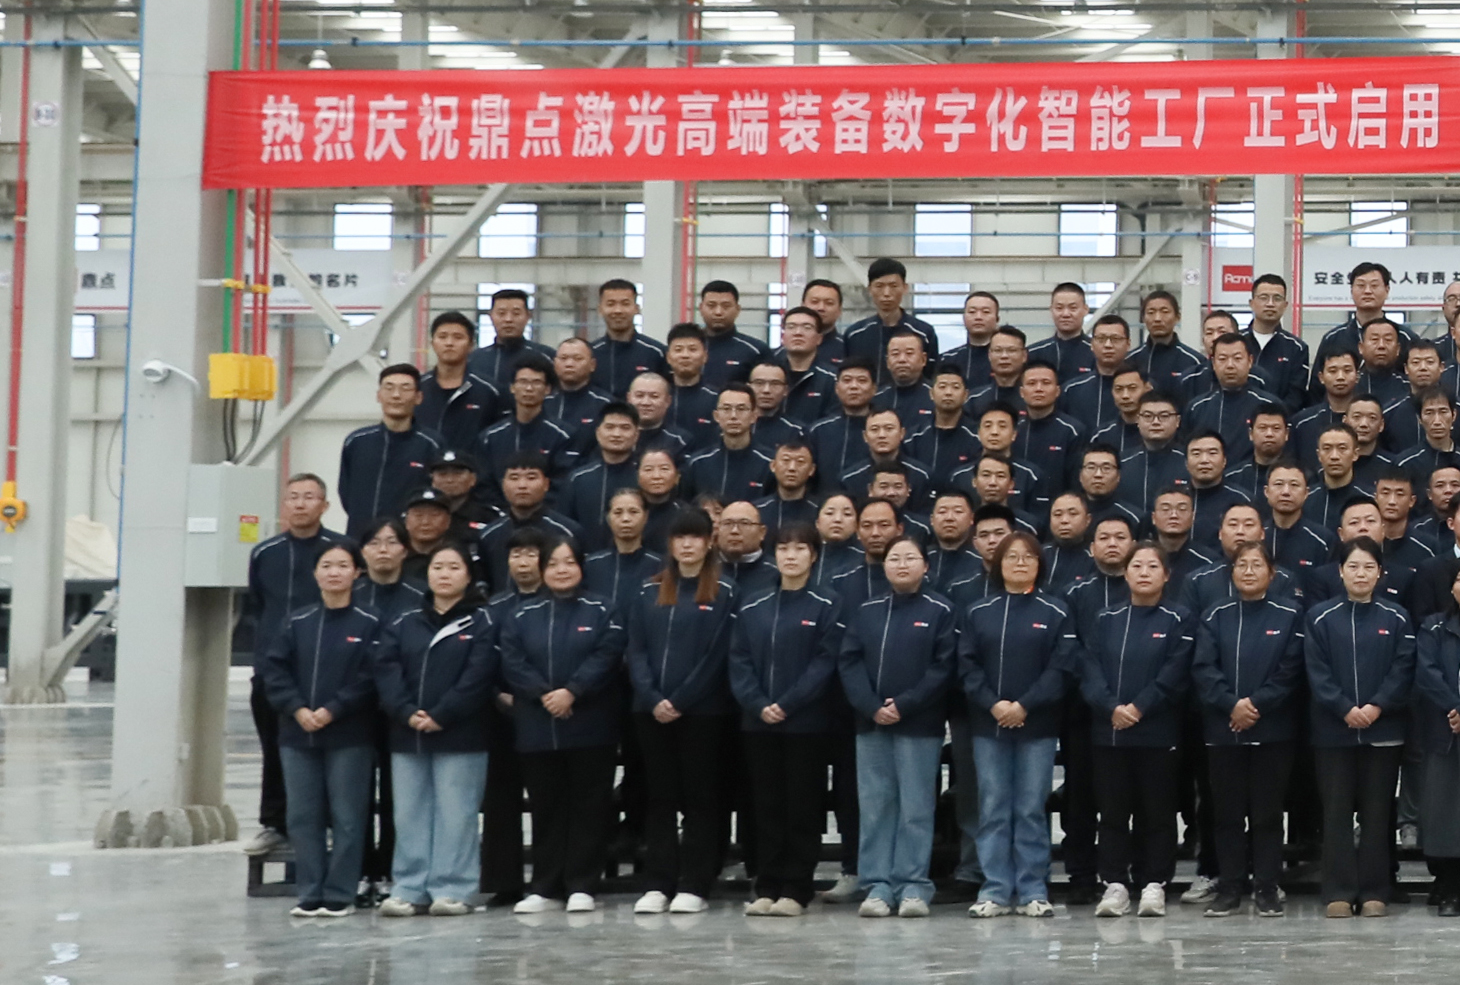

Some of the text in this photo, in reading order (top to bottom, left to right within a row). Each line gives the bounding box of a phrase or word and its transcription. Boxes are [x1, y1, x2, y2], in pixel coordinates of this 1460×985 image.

[260, 81, 1441, 165] 热烈庆祝鼎点激光高端装备数字化智能工厂正式启用
